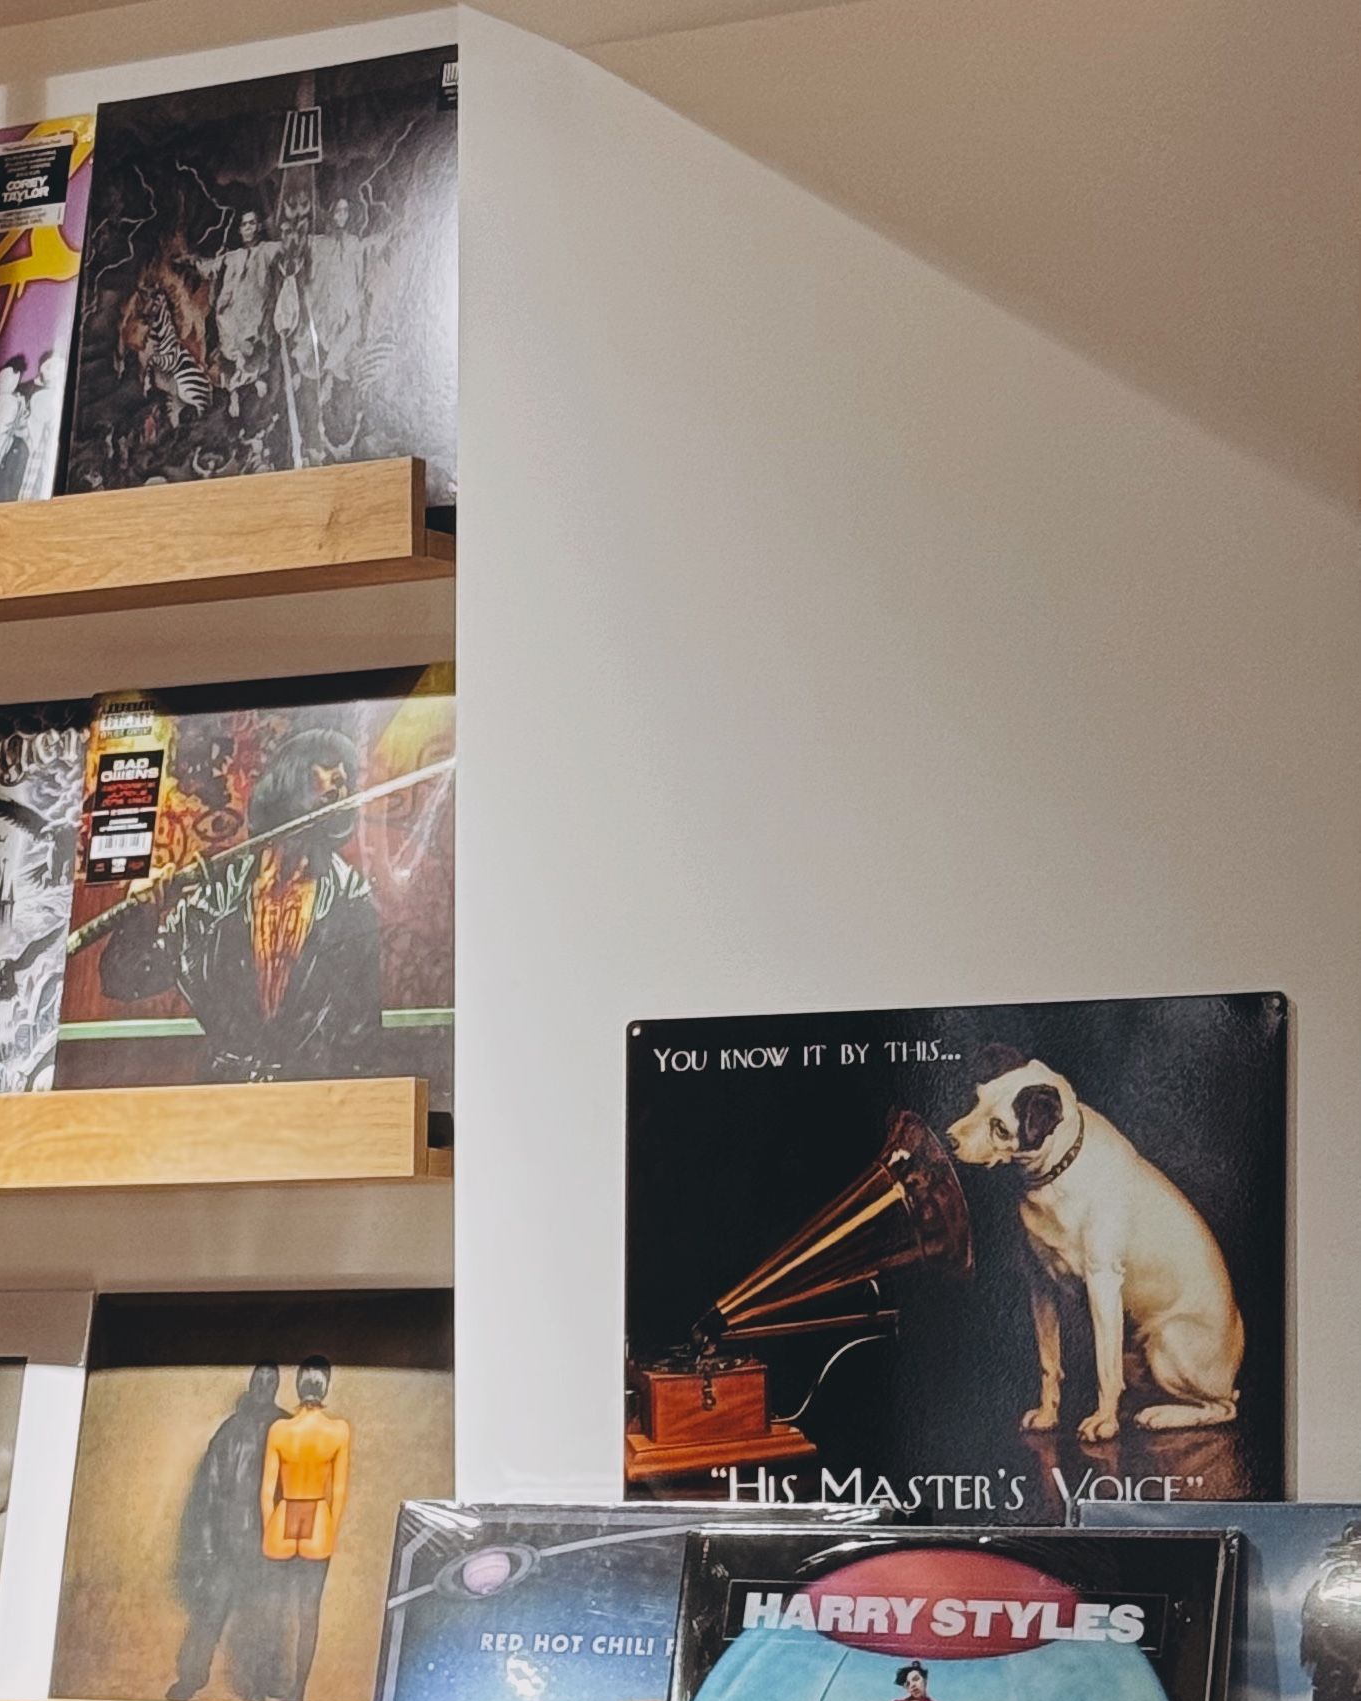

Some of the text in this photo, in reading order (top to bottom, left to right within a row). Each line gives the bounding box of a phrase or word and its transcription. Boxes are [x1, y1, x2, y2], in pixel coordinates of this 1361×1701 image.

[6, 175, 48, 191] COREY
[2, 186, 50, 204] TAYLOR
[113, 758, 149, 771] BAD
[653, 1048, 707, 1072] YOU
[720, 1047, 789, 1070] KNOW
[803, 1045, 827, 1066] IT
[841, 1043, 869, 1065] BY
[742, 1592, 1146, 1645] HARRY STYLES
[480, 1633, 524, 1653] RED
[534, 1634, 584, 1654] HOT
[592, 1635, 654, 1657] CHILI
